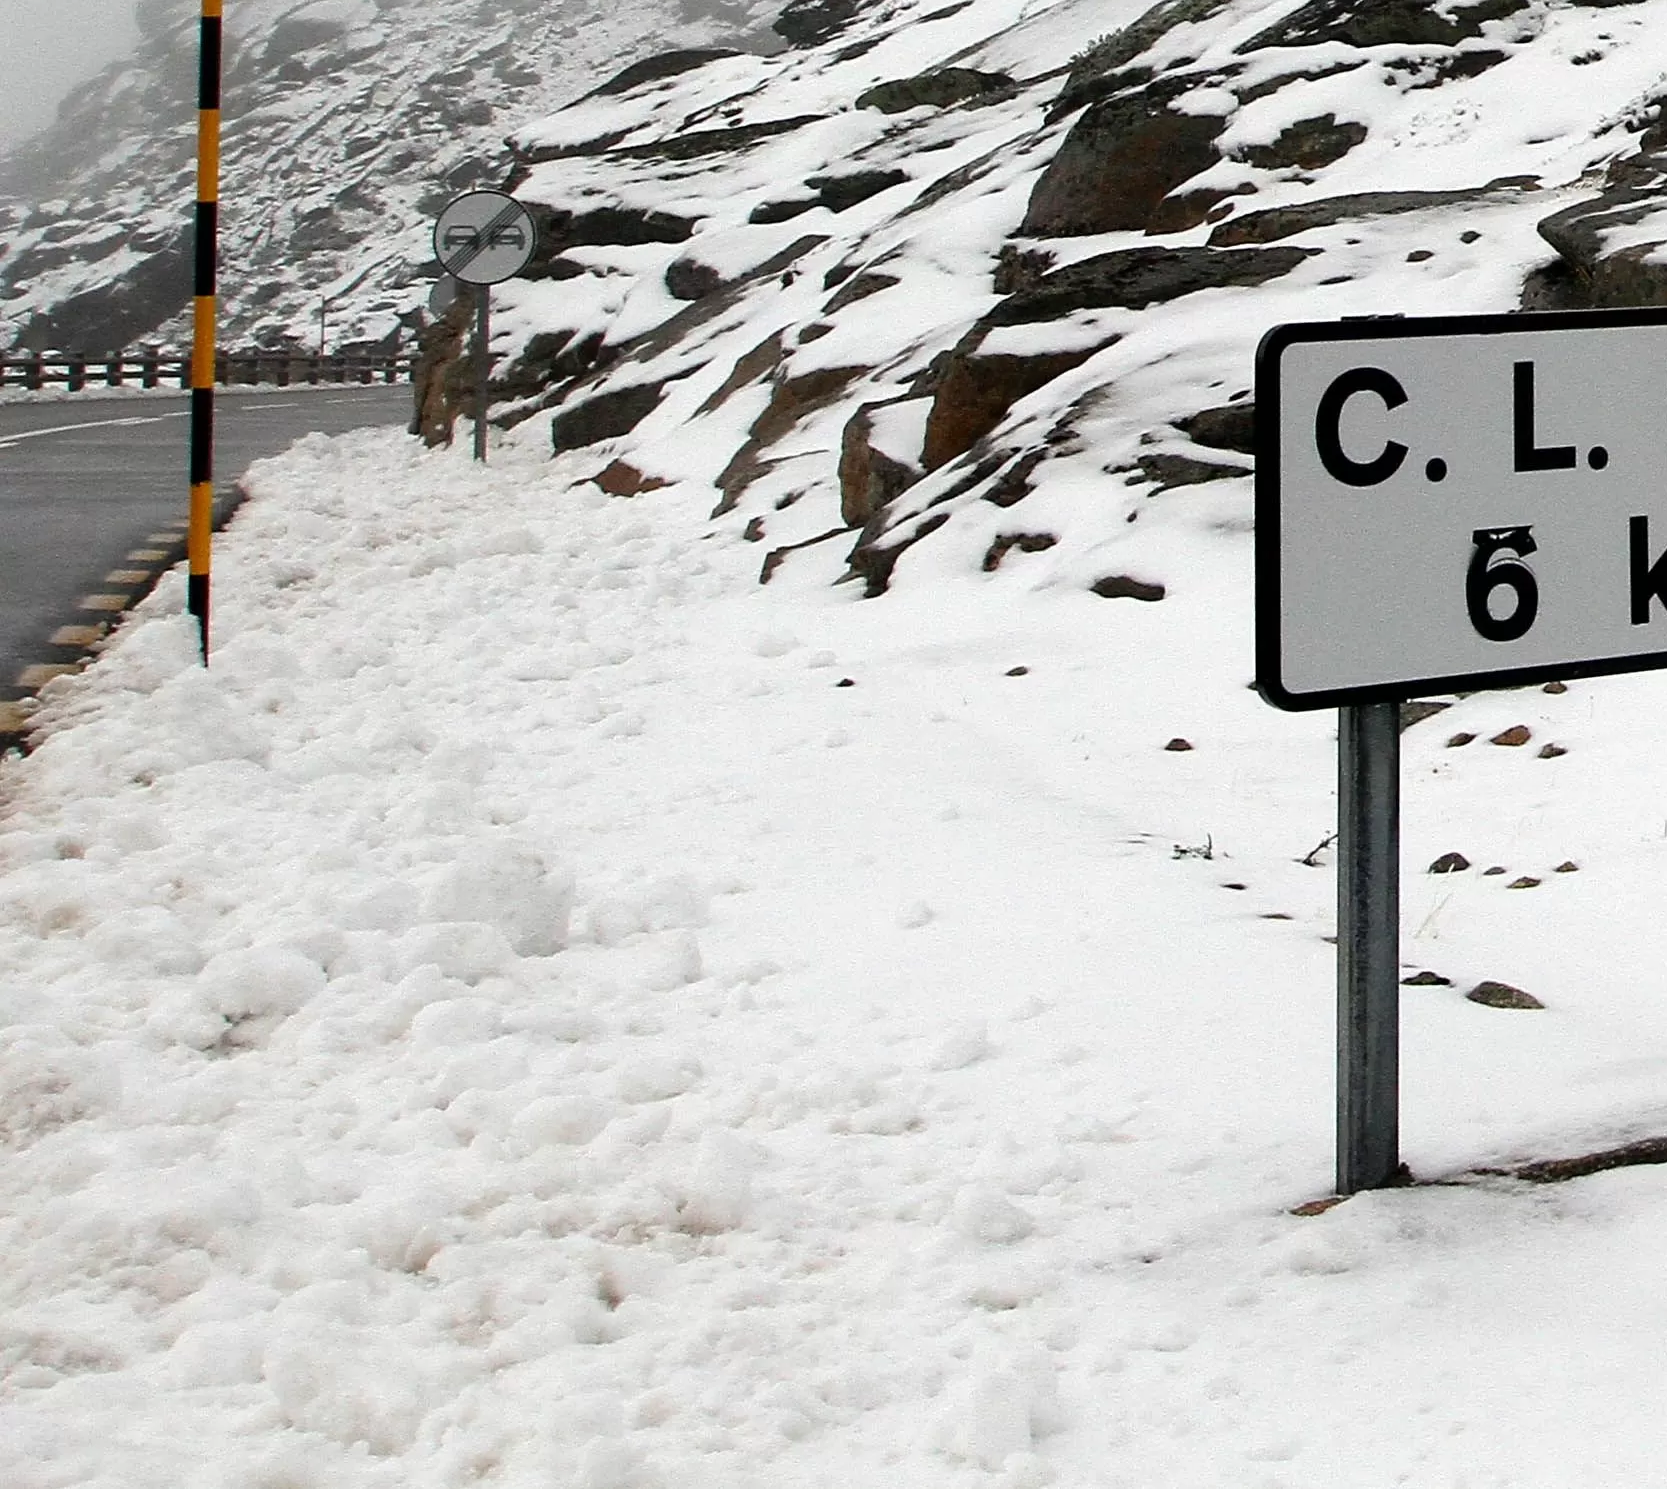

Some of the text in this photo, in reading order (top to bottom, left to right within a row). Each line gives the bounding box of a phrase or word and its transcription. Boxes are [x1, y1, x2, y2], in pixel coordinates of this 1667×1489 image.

[1315, 366, 1448, 487] C.
[1513, 360, 1609, 473] L.
[1465, 524, 1539, 642] 6
